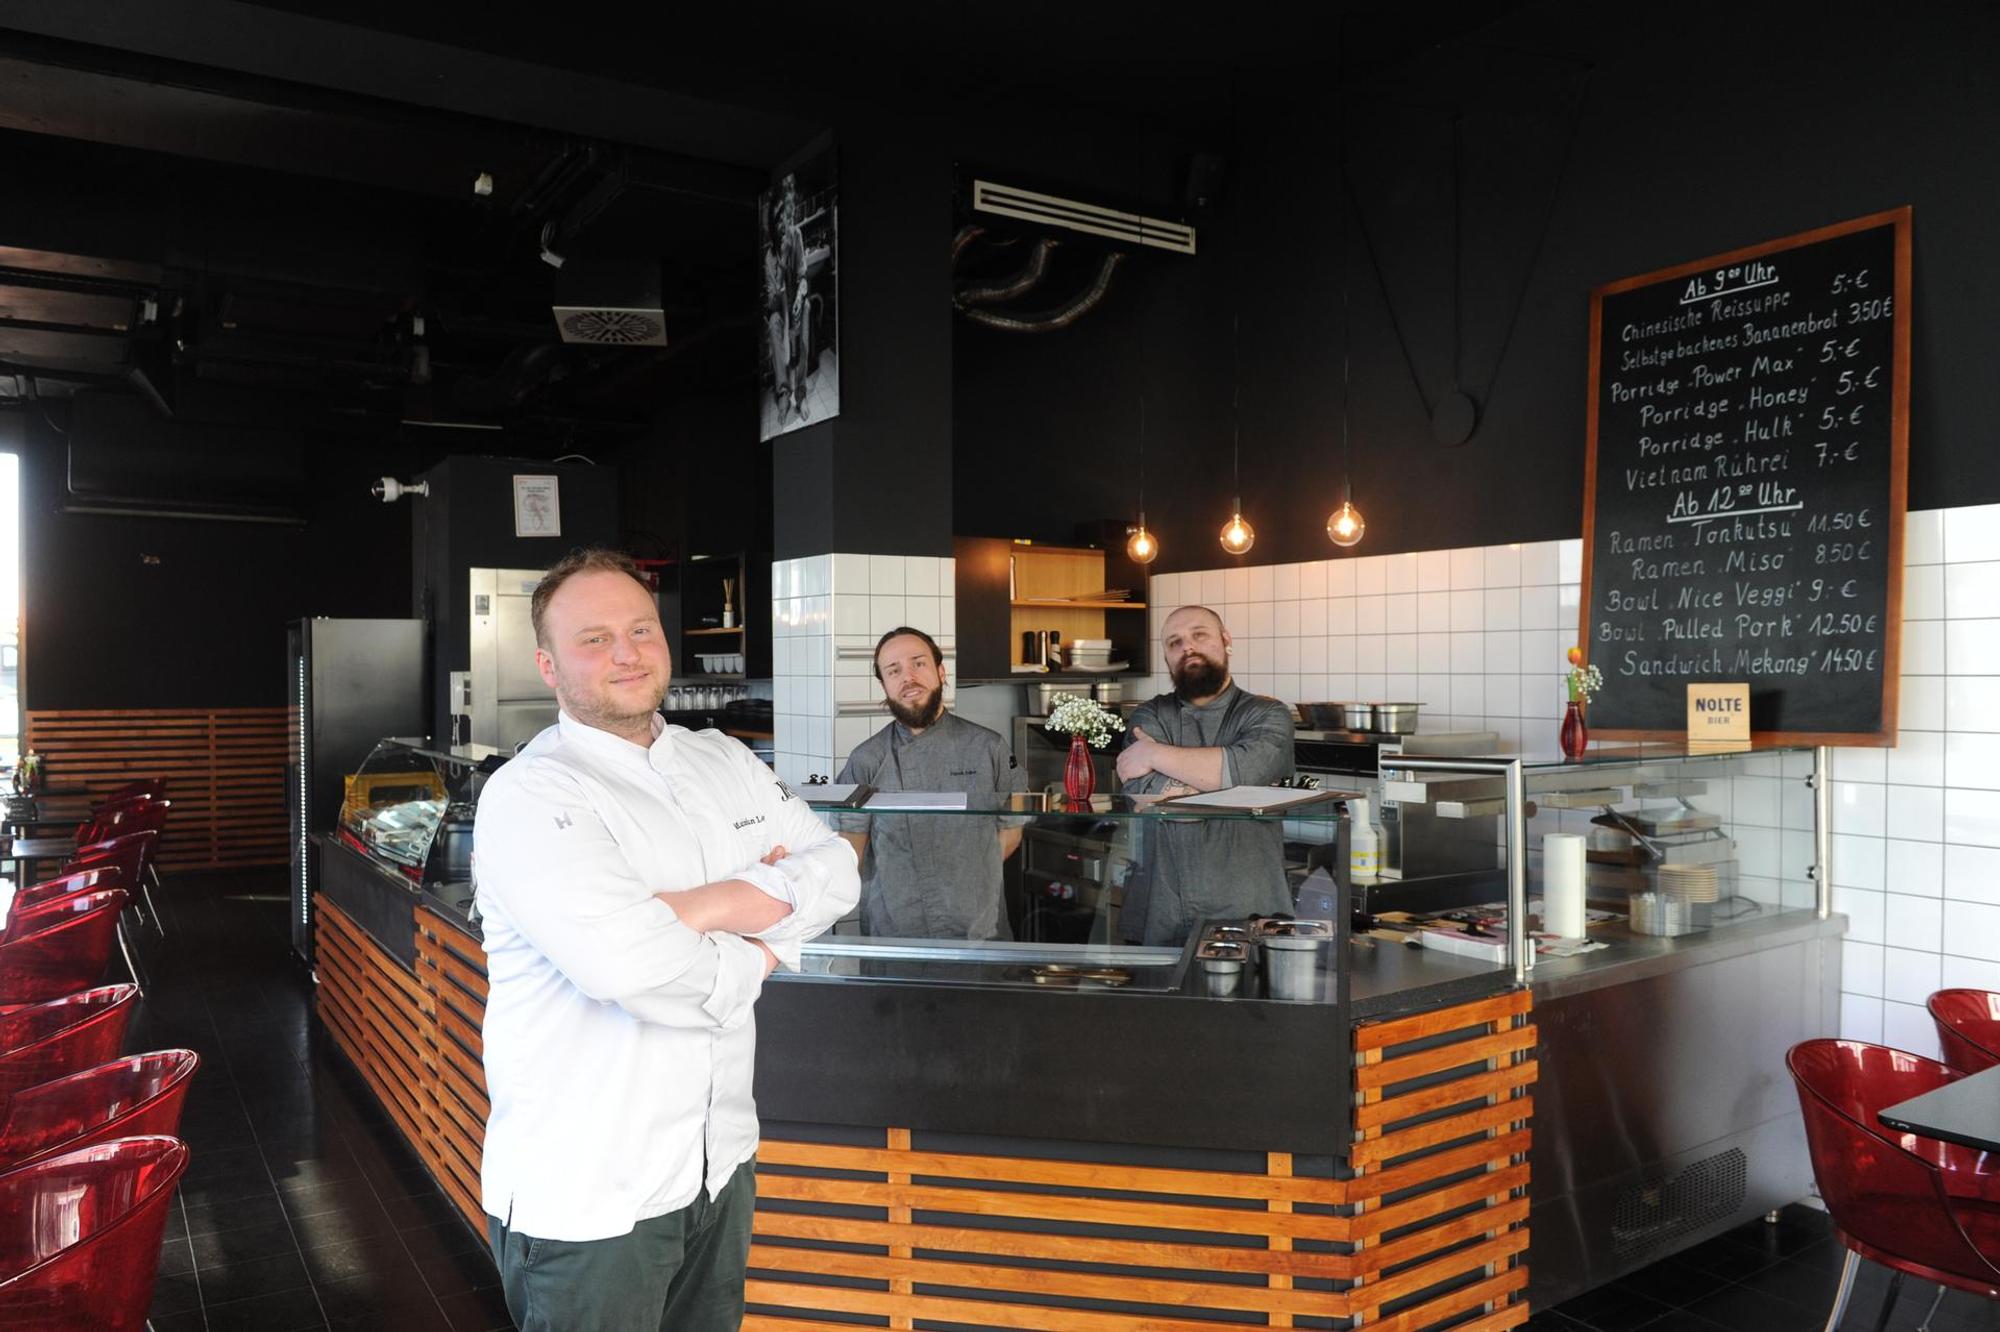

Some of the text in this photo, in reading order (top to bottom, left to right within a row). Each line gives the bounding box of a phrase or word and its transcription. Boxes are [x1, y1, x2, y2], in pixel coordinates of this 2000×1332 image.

[1684, 278, 1707, 299] Ab
[1744, 262, 1776, 284] Uhr
[1622, 307, 1702, 341] Chinesische
[1711, 292, 1791, 322] Reissuppe
[1620, 334, 1738, 371] Selbstgebackenes
[1742, 308, 1838, 346] Bananenbrot
[1611, 378, 1679, 403] Porridge
[1640, 399, 1729, 427] Porridge
[1639, 432, 1724, 458] Porridge
[1626, 464, 1708, 491] Vietnam
[1714, 449, 1790, 478] Rührei
[1673, 491, 1699, 517] Ab
[1758, 481, 1797, 506] Uhr
[1610, 531, 1674, 554] Ramen
[1631, 558, 1705, 580] Ramen
[1604, 588, 1659, 612] Bowl
[1599, 622, 1645, 642] Bowl
[1619, 648, 1722, 676] Sandwich
[1695, 697, 1742, 712] NOLTE
[1707, 716, 1730, 725] BIER
